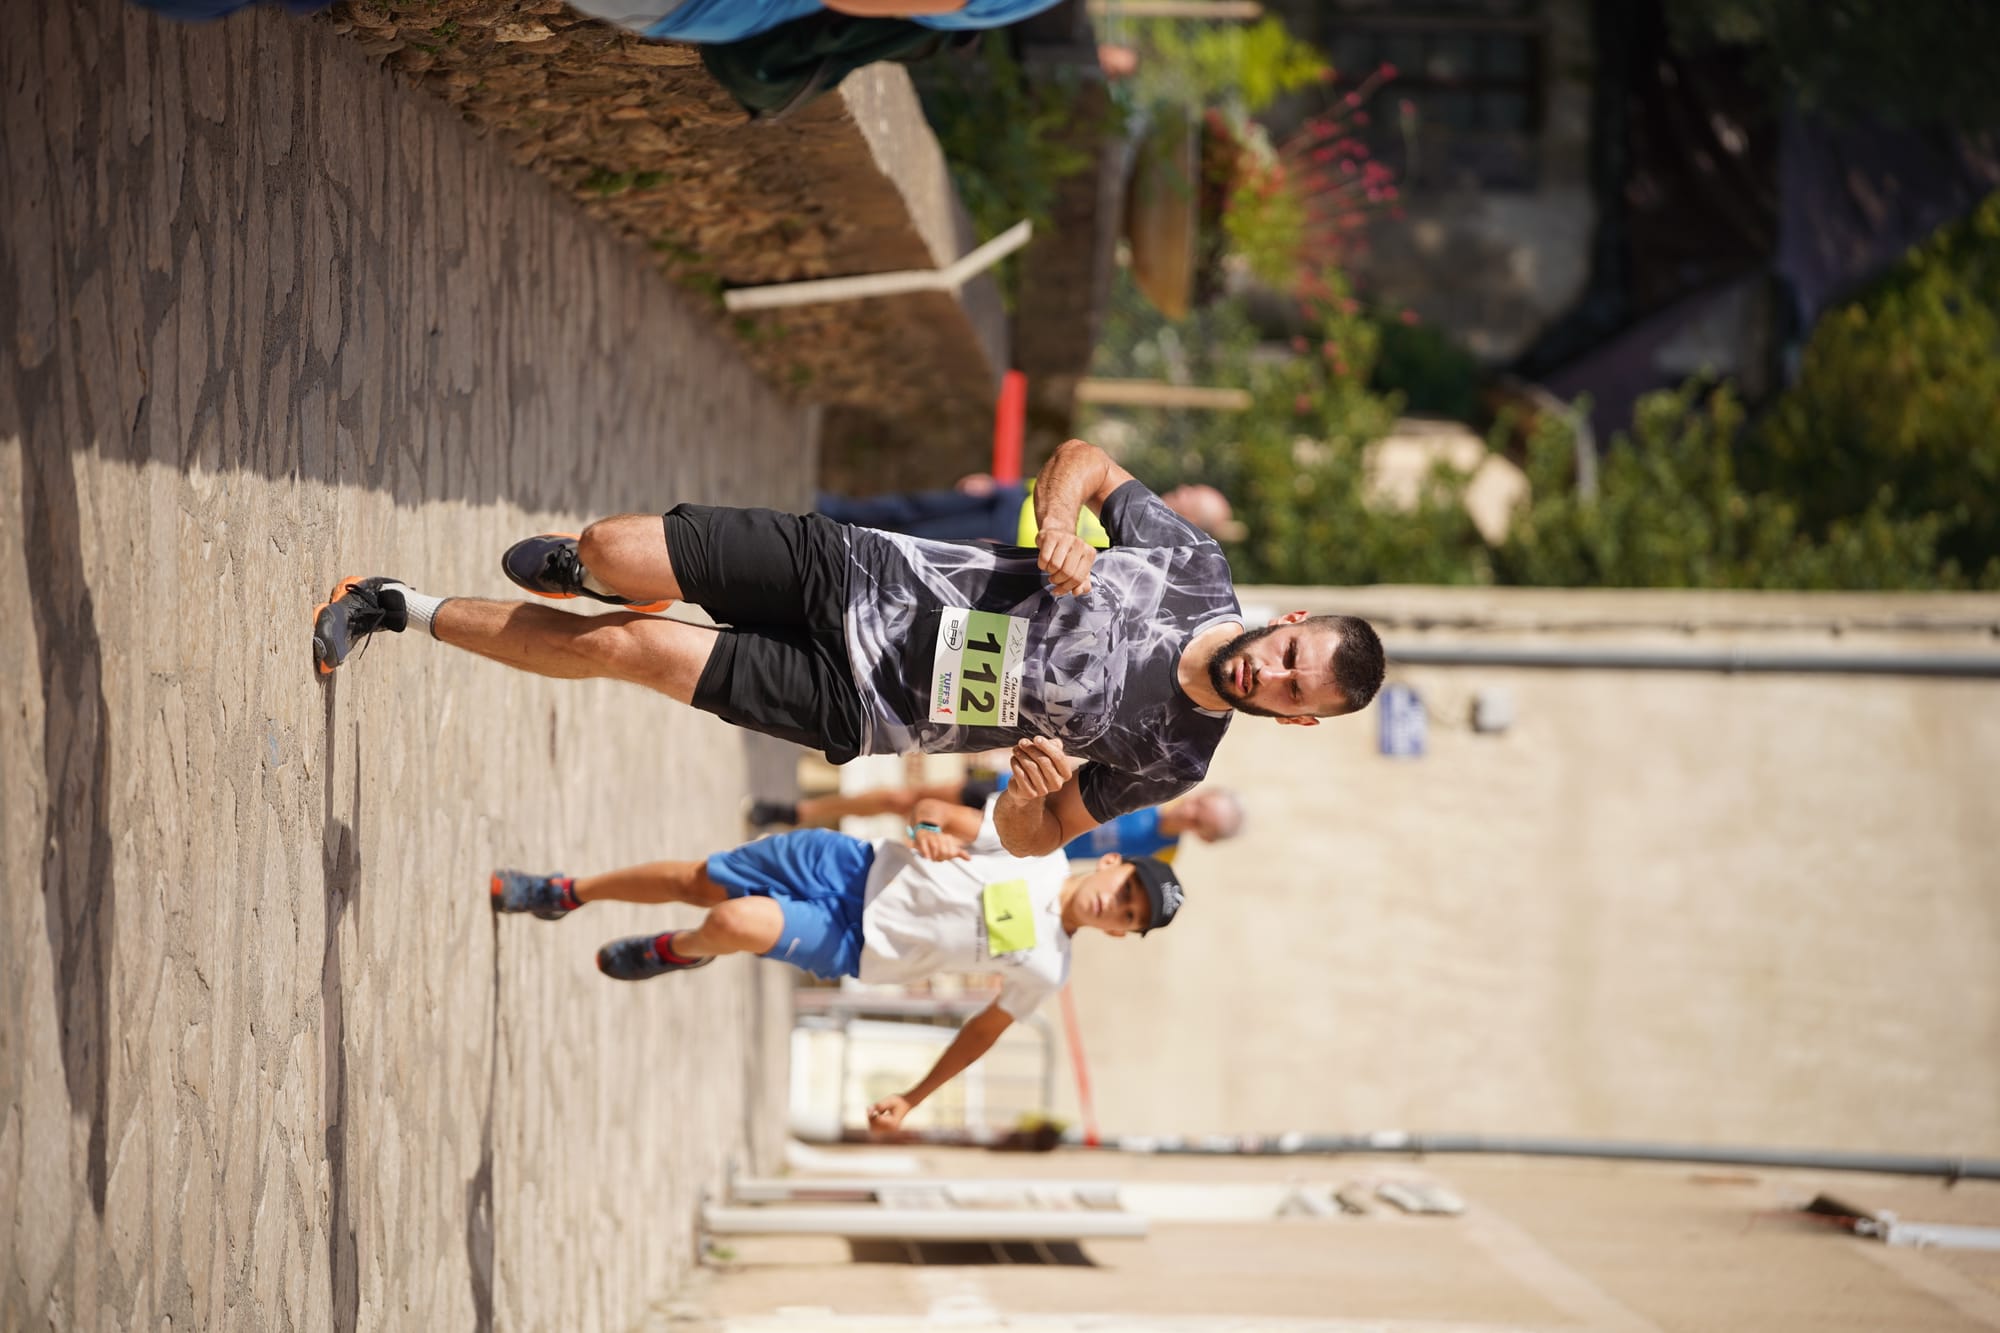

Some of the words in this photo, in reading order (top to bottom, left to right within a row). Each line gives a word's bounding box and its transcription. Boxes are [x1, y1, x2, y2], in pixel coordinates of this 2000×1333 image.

[943, 672, 952, 704] TUFF'S
[960, 632, 1001, 713] 112
[997, 909, 1013, 922] 1
